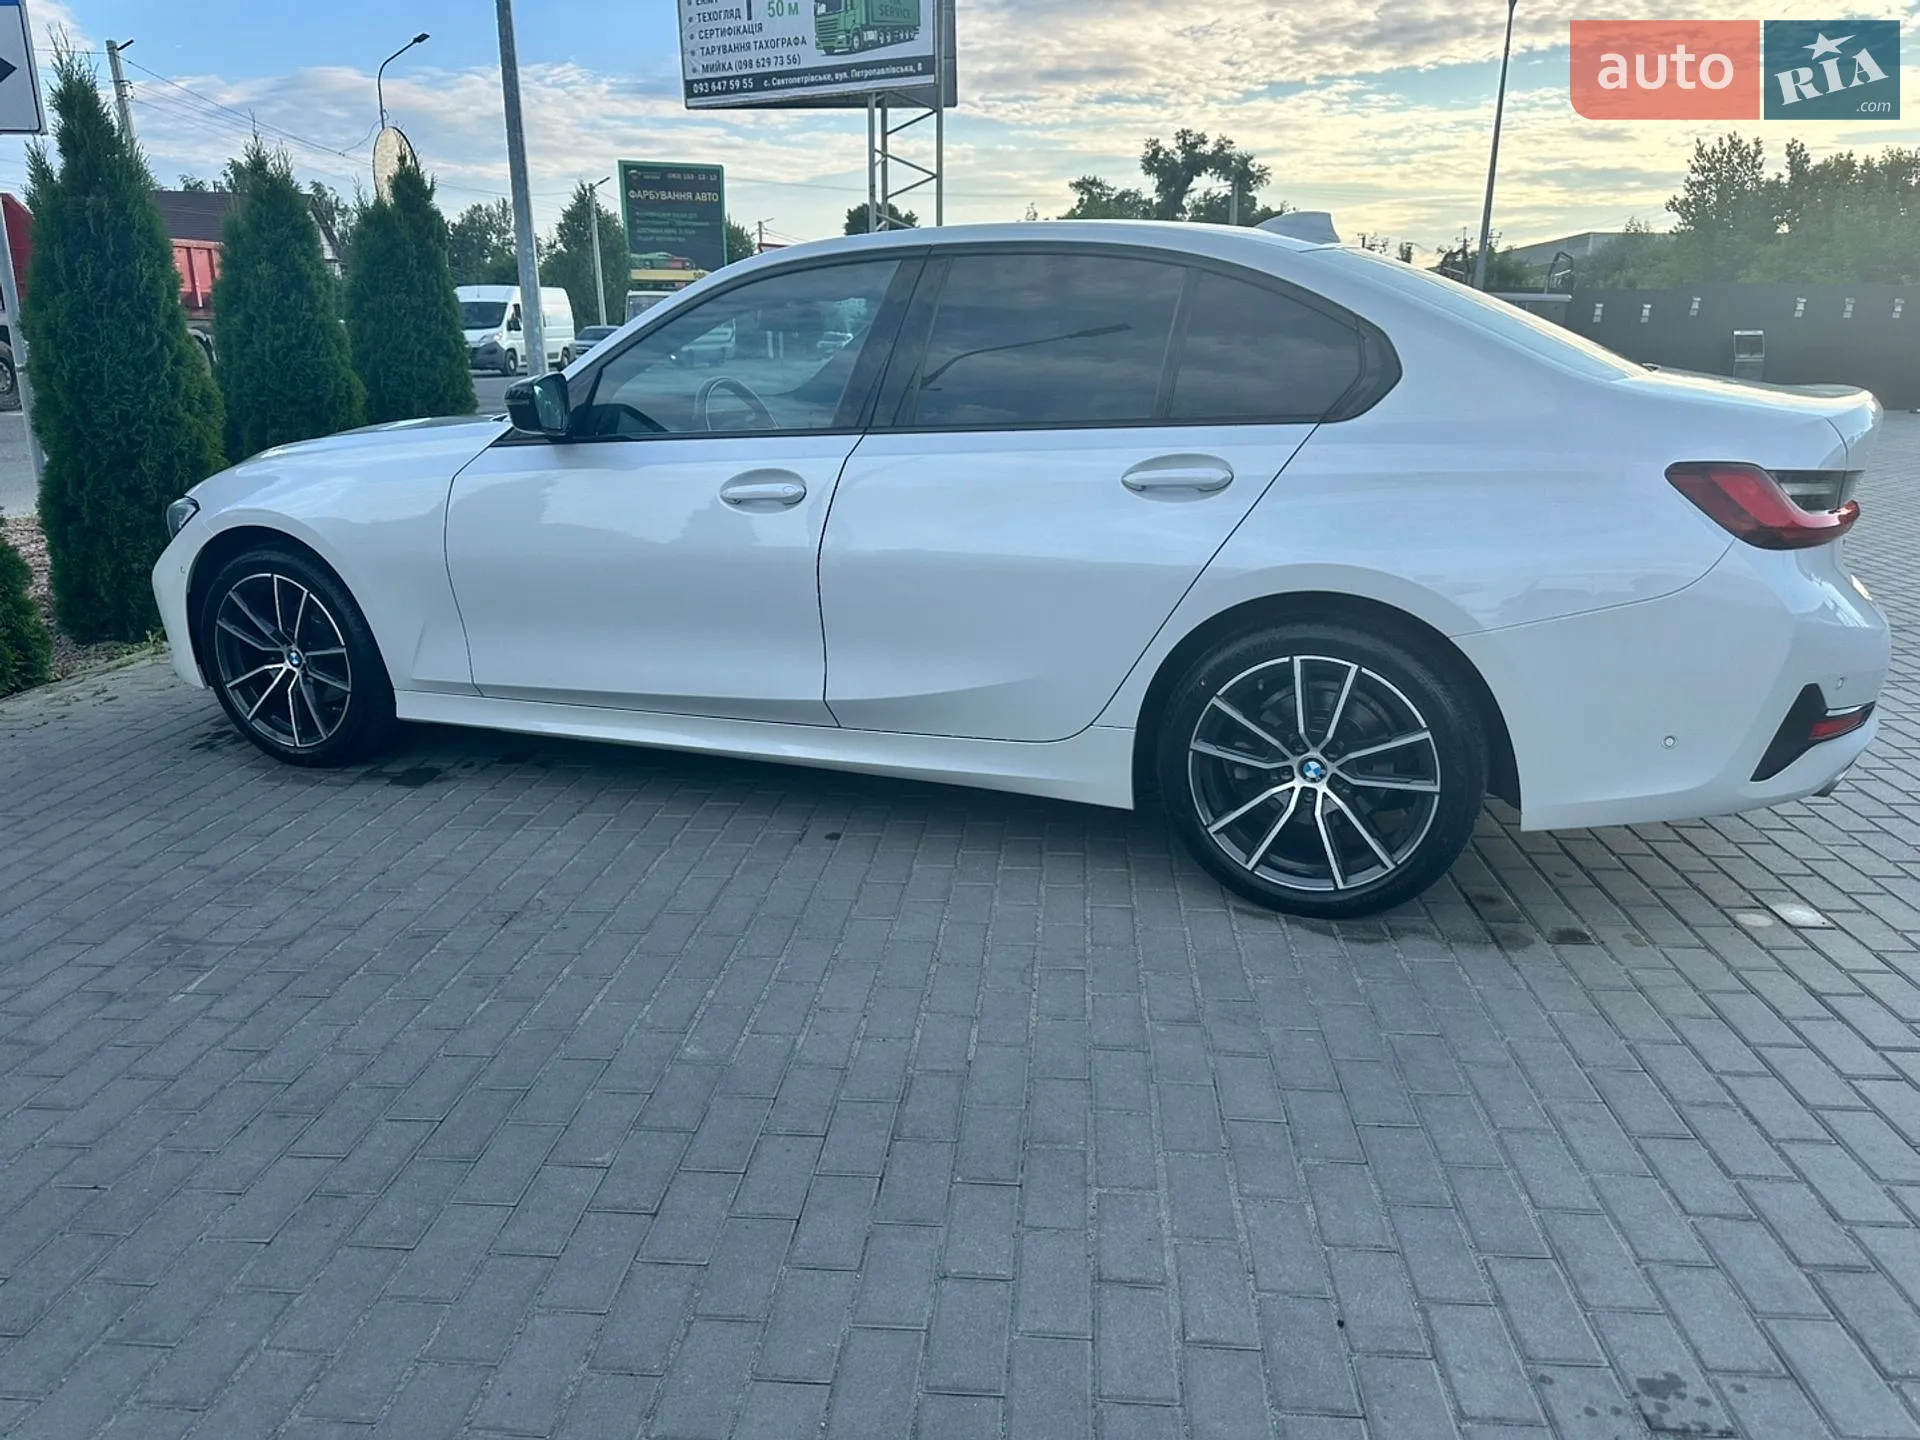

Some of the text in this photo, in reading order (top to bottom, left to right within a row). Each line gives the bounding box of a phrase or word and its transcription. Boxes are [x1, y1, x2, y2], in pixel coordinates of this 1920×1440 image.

[696, 8, 741, 22] ТЕХОГЛЯД
[698, 23, 763, 40] СЕРТИФІКАЦІЯ
[700, 36, 807, 56] ТАРУВАННЯ ТАХОГРАФА
[701, 60, 733, 73] МИЙКА
[755, 57, 771, 69] 629
[774, 55, 784, 67] 73
[729, 79, 740, 90] 59
[742, 78, 753, 88] 55
[628, 189, 719, 202] ФАРБУВАННЯ АВТО
